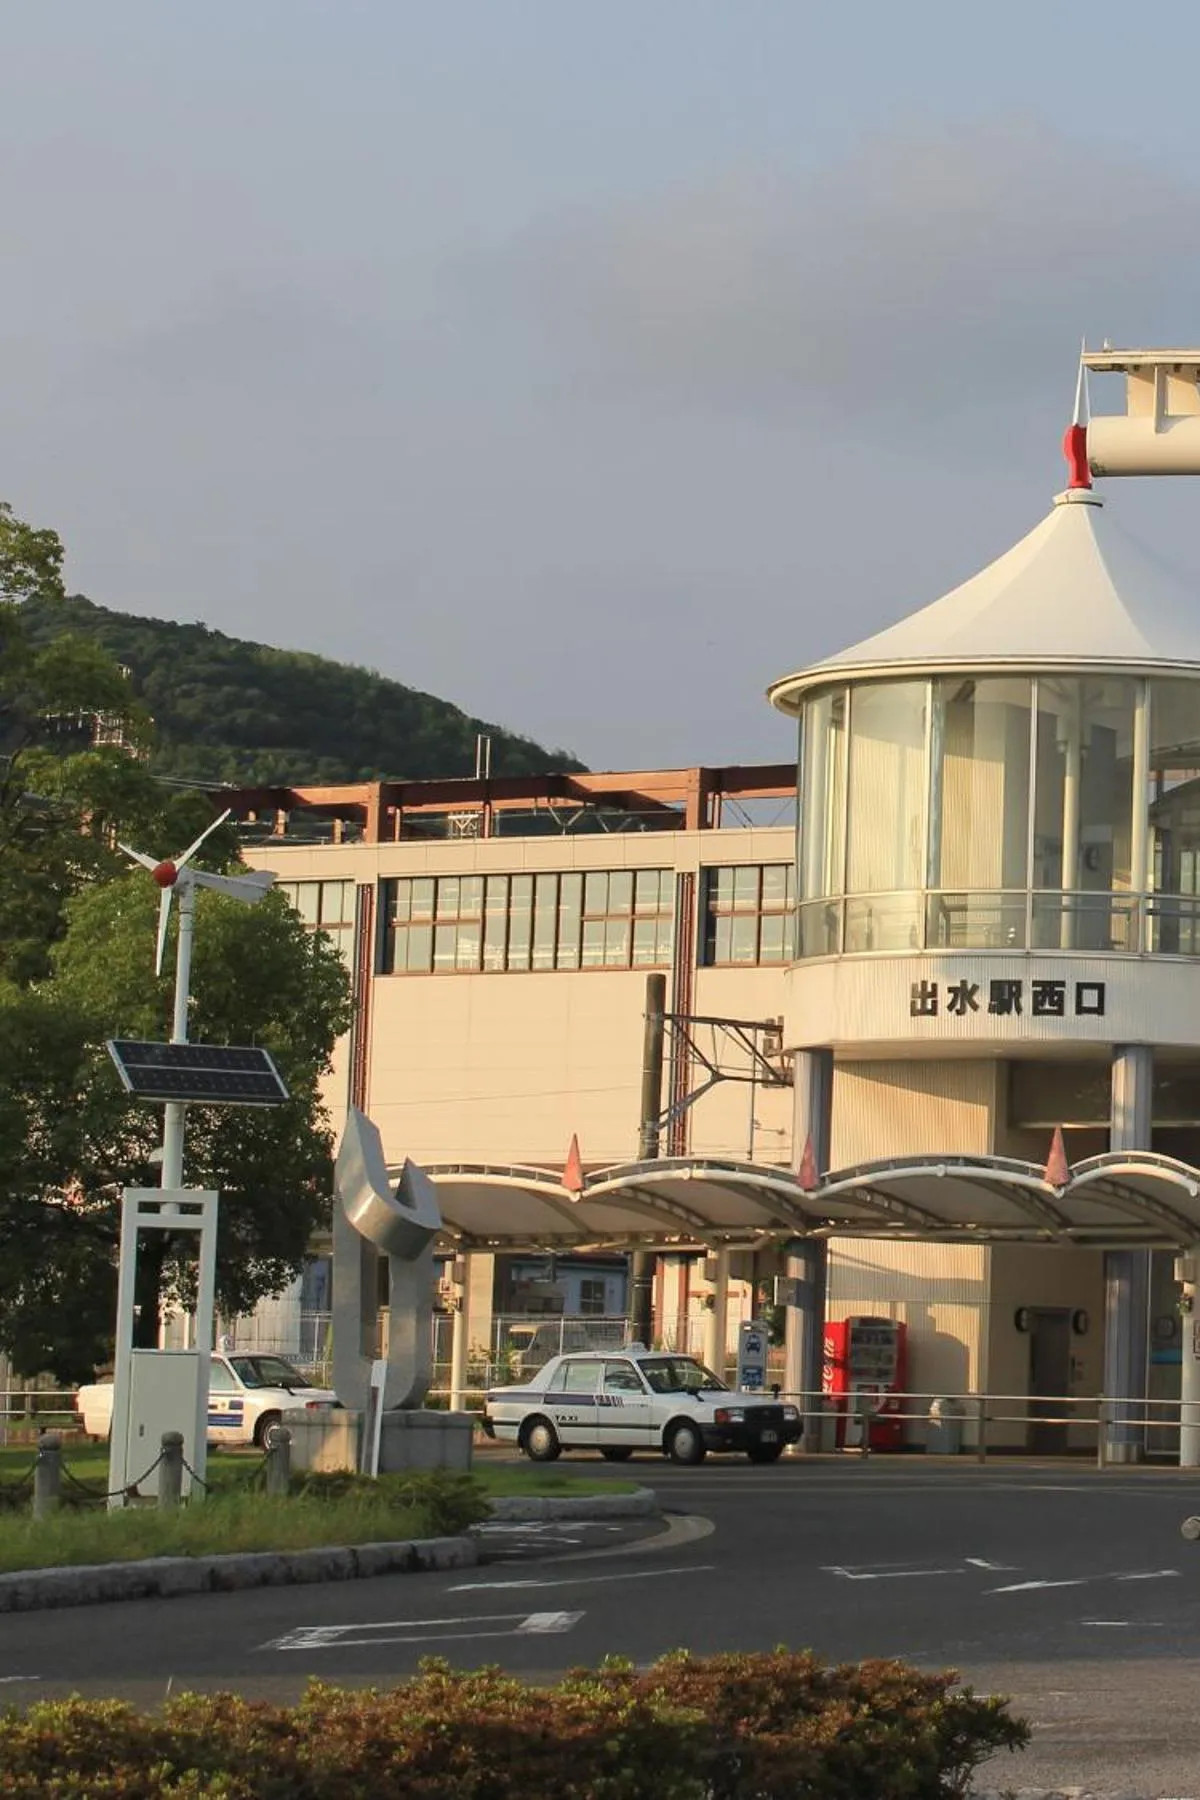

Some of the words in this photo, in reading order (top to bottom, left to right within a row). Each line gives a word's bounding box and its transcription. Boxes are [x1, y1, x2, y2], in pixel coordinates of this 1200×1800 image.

[910, 979, 1105, 1016] 出水駅西口
